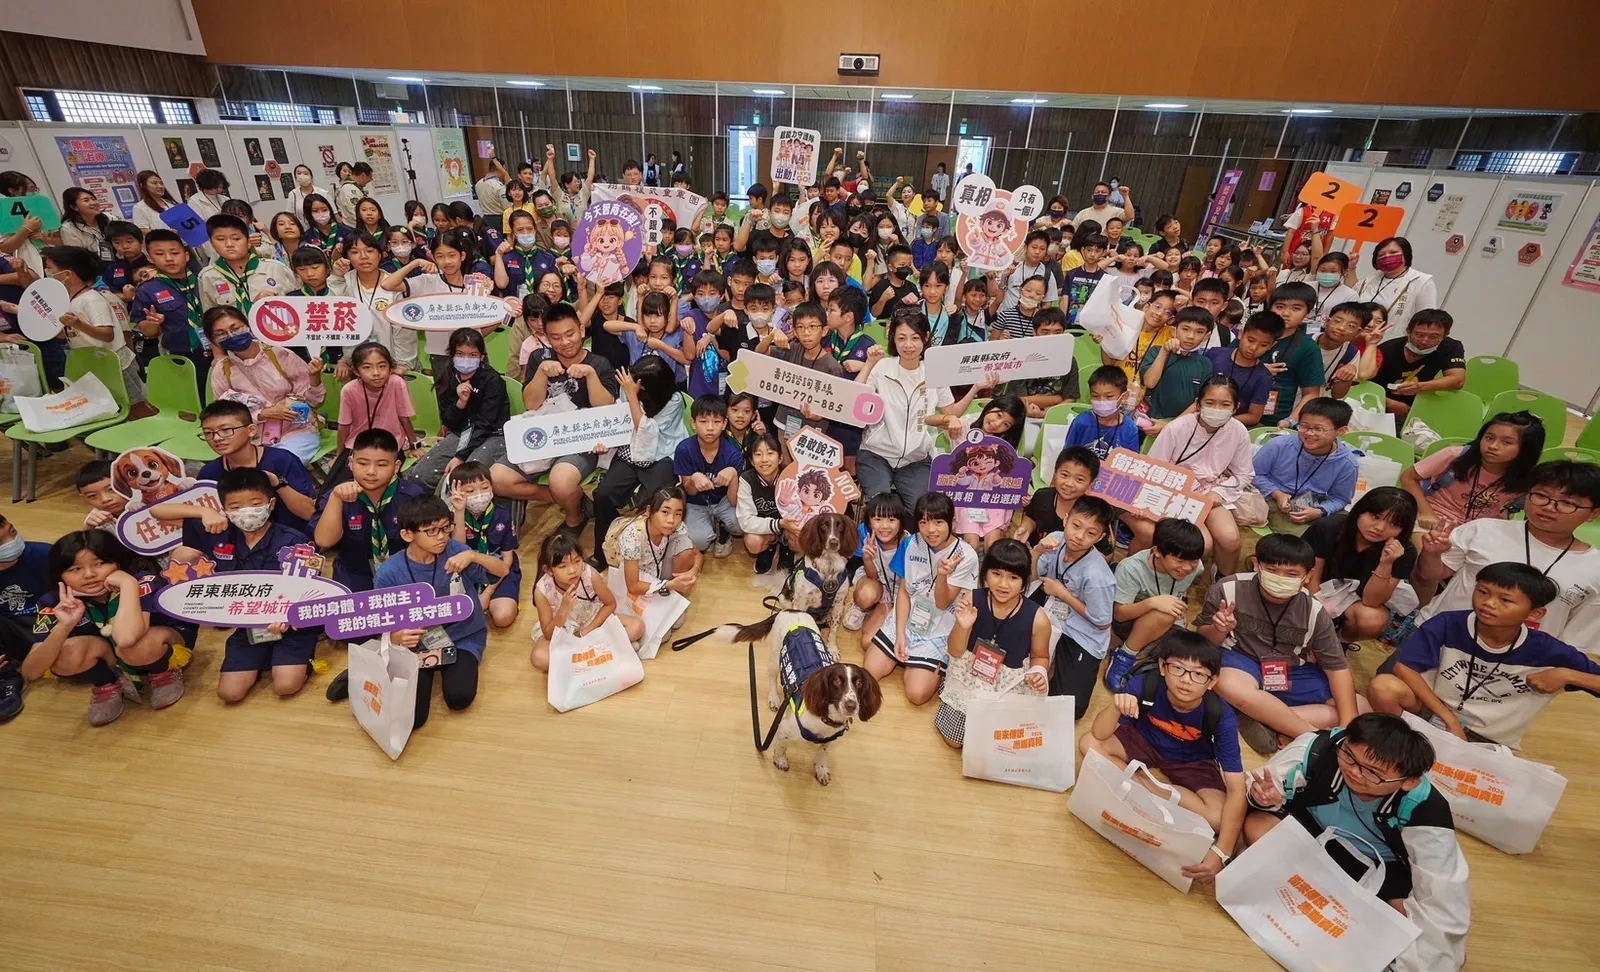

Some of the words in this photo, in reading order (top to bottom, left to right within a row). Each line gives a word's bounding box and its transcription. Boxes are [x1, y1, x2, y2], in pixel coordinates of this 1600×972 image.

[959, 184, 993, 207] 真相
[1018, 192, 1037, 205] 只有
[1321, 182, 1341, 200] 2
[10, 201, 29, 218] 4
[584, 203, 641, 227] 今天智商在線!
[1014, 205, 1035, 217] 一個!
[181, 217, 201, 231] 5
[1357, 209, 1379, 228] 2
[305, 301, 358, 333] 禁菸
[960, 351, 1011, 365] 屏東縣政府
[984, 360, 1024, 372] 希望城市
[773, 367, 834, 396] 毒防諮詢專線
[759, 379, 844, 413] 0800-770-885
[796, 434, 839, 459] 勇敢說不
[1110, 452, 1188, 491] 衛來傳說
[834, 474, 859, 500] NO!
[980, 492, 1022, 505] 做出選擇
[186, 583, 274, 598] 屏東縣政府
[228, 600, 295, 616] 希望城市
[1487, 785, 1505, 795] 2026
